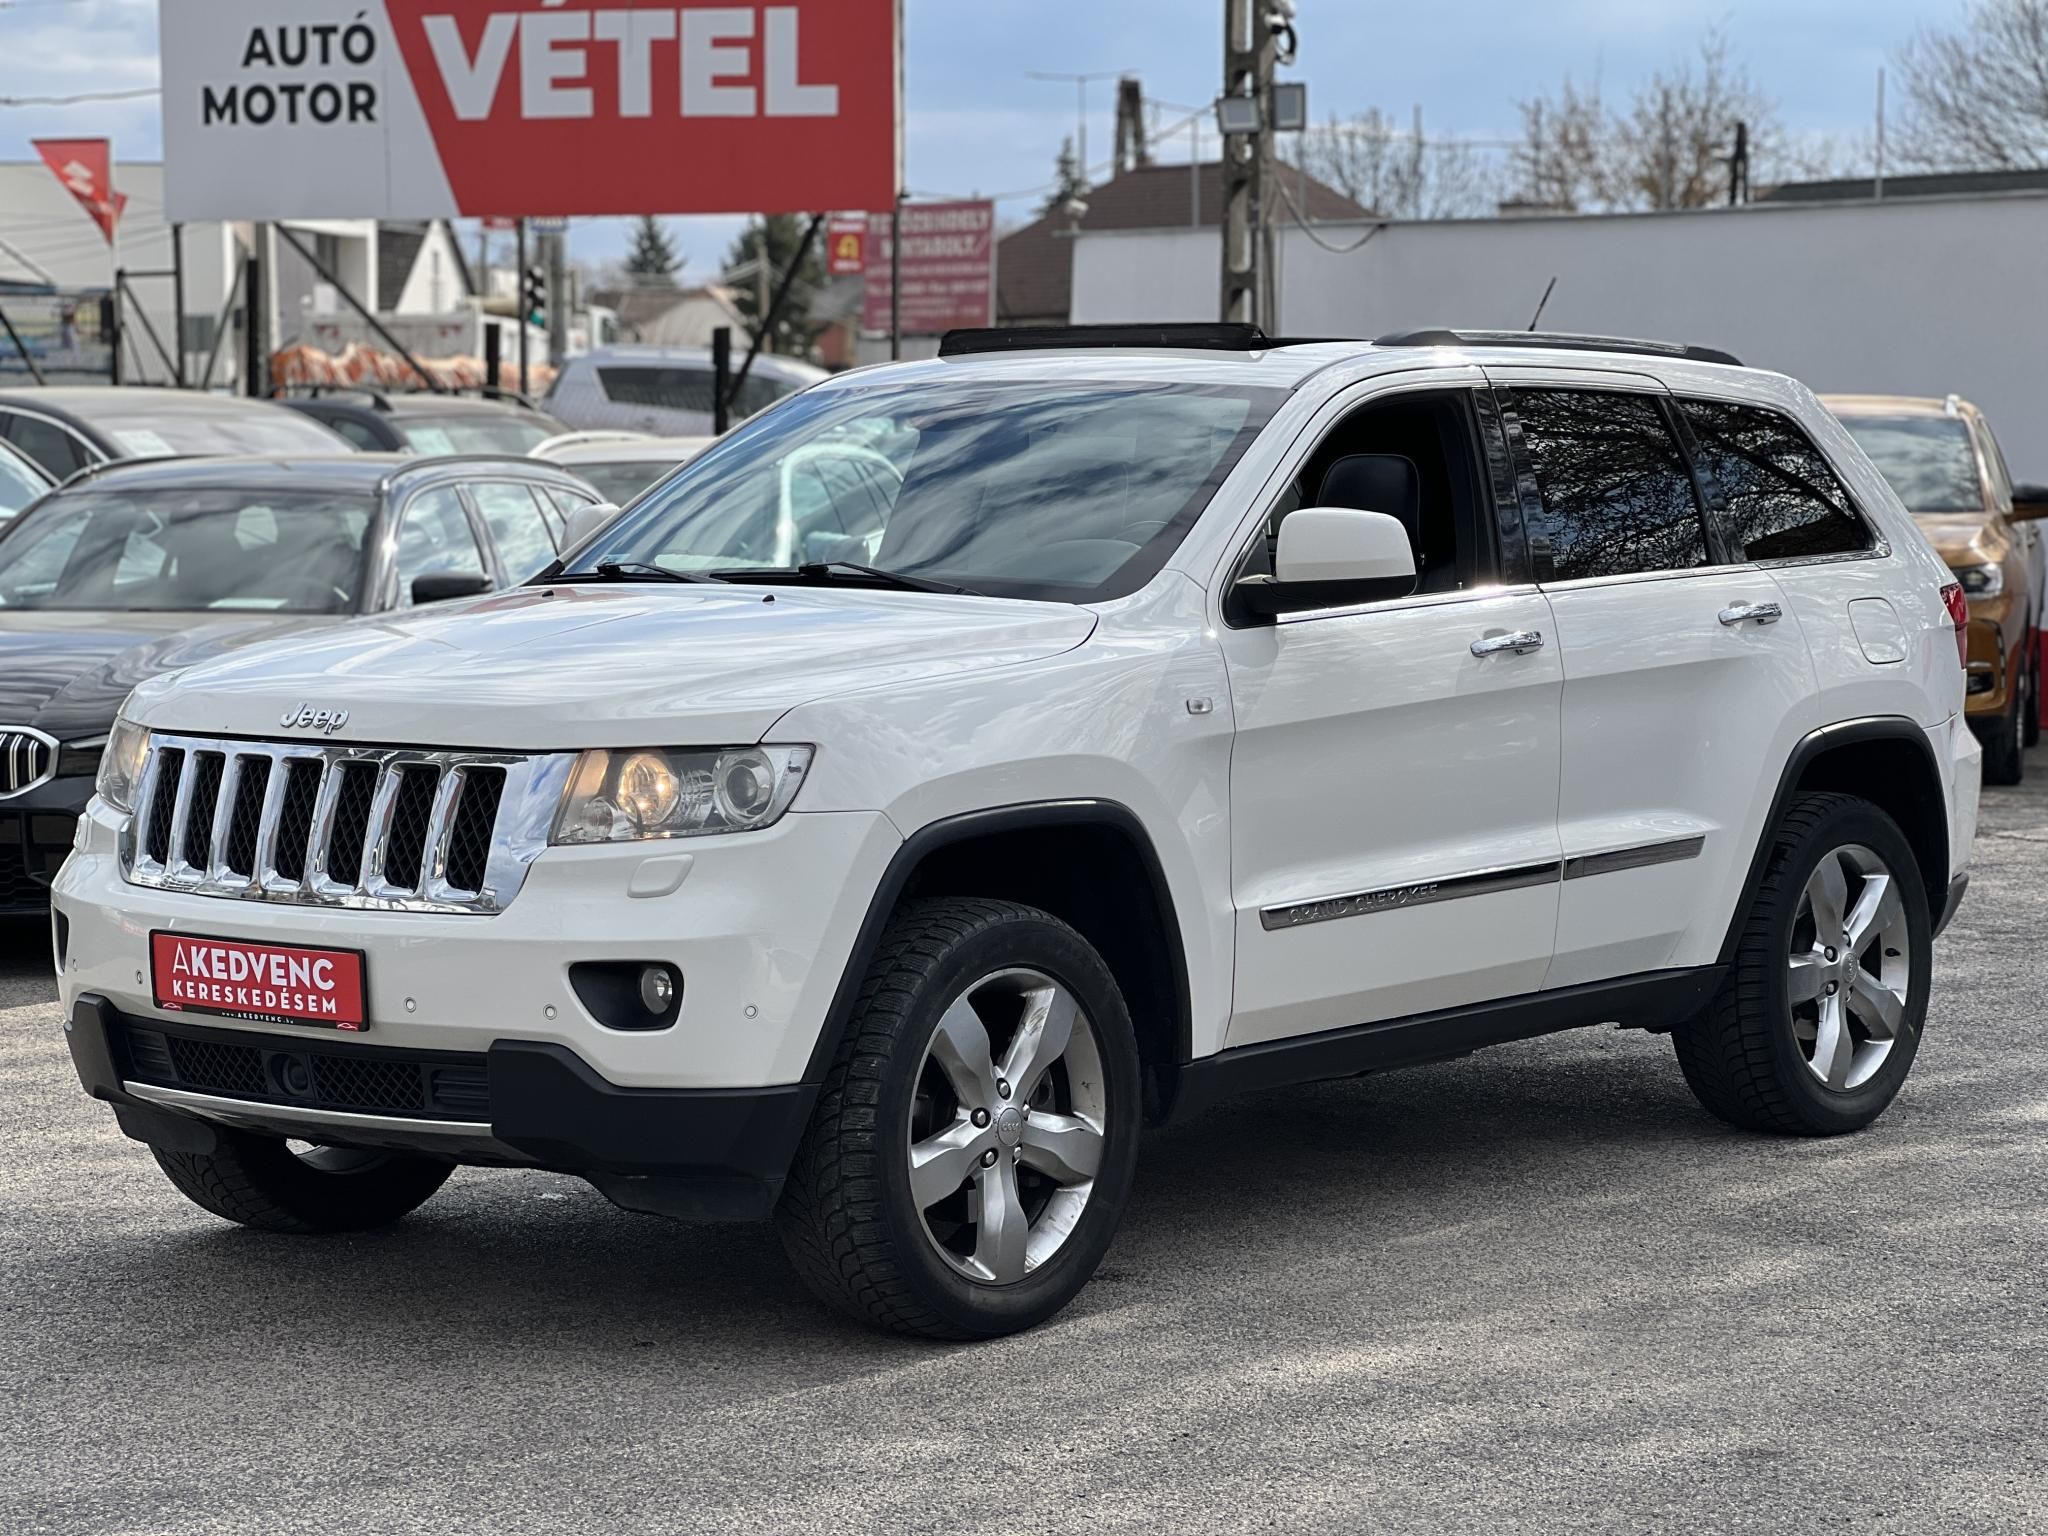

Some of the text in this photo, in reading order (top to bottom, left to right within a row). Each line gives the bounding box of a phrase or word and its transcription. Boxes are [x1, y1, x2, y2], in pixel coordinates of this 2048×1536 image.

[242, 10, 376, 67] AUTÓ
[421, 0, 839, 120] VÉTEL
[203, 82, 377, 125] MOTOR
[280, 702, 348, 735] Jeep
[1289, 883, 1438, 923] GRAND CHEROKEE
[172, 941, 336, 991] AKEDVENC
[172, 979, 337, 1014] KERESKEDÉSEM
